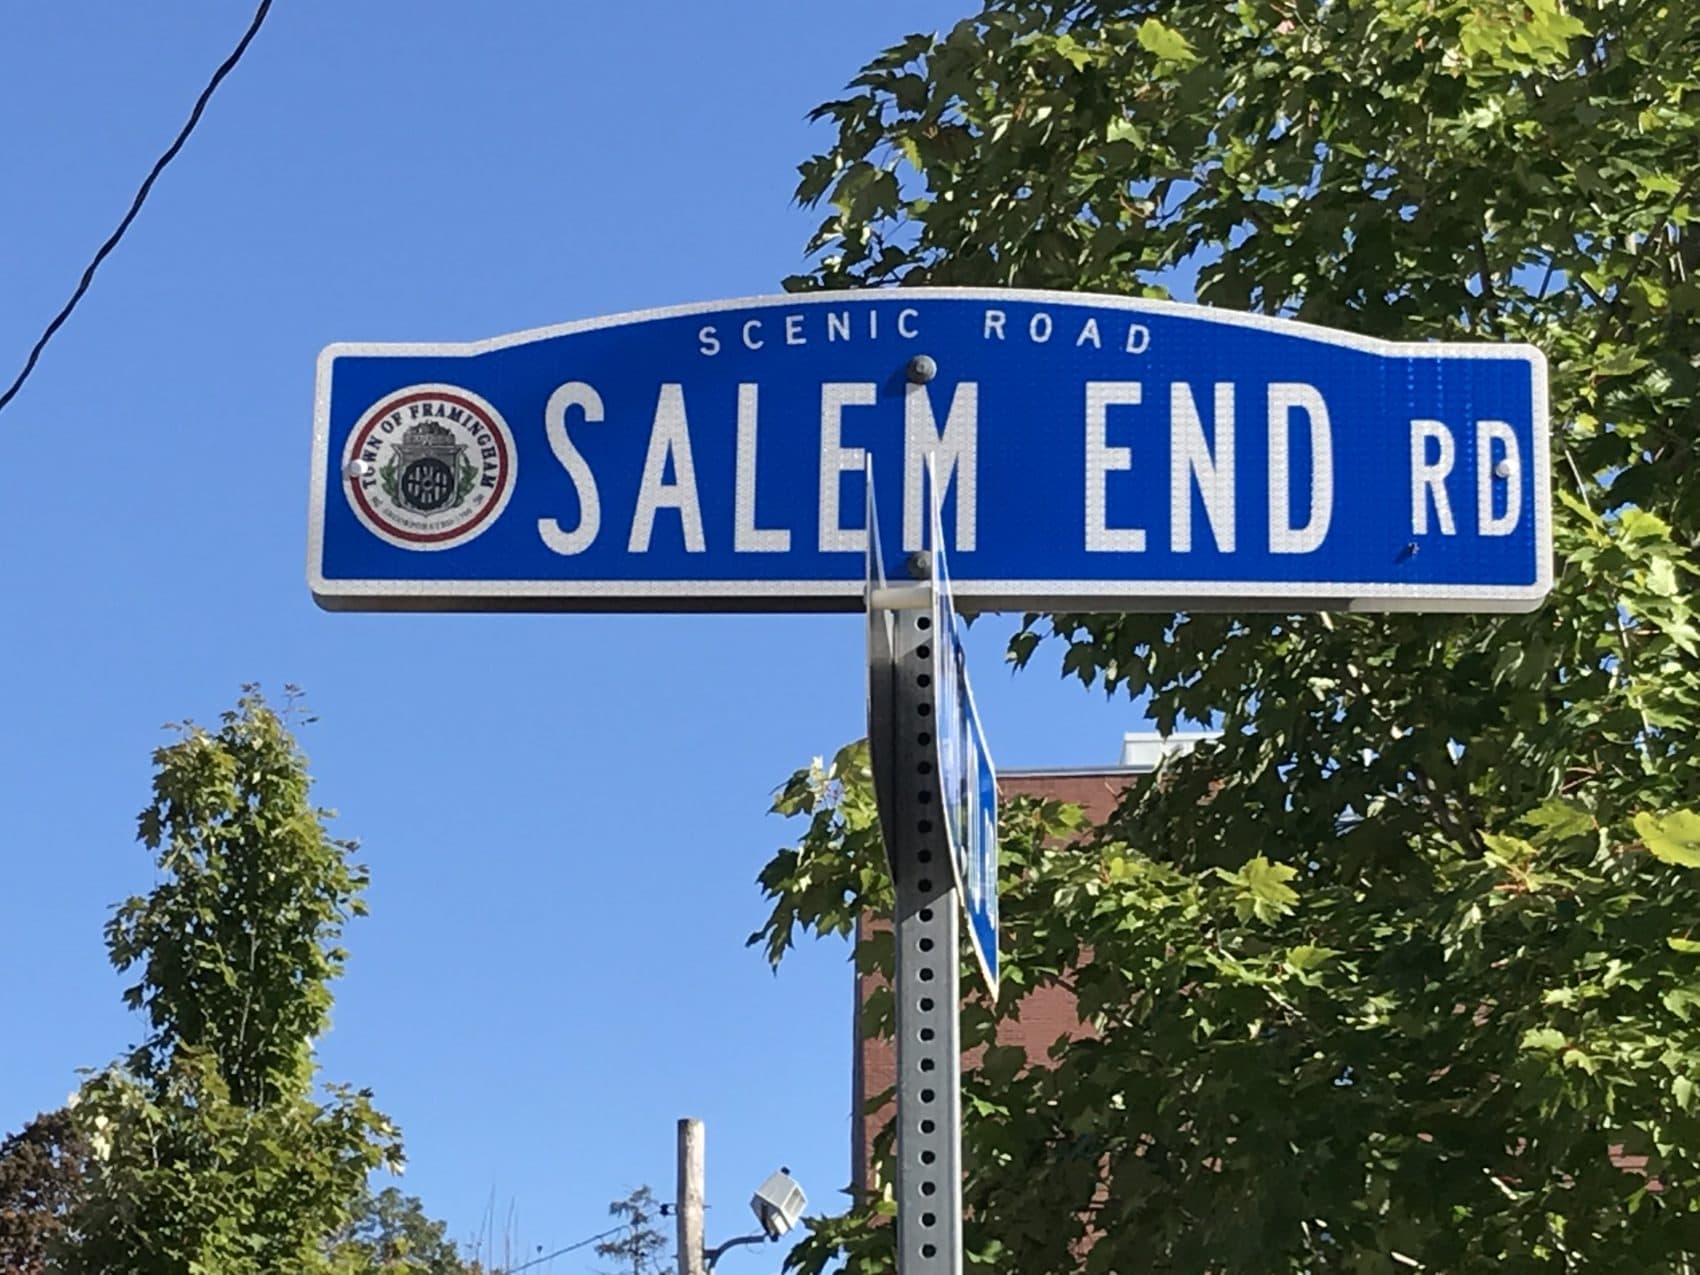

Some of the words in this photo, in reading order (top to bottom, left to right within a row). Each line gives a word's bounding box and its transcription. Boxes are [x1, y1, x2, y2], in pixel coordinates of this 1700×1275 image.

[698, 308, 920, 357] SCENIC
[983, 309, 1152, 355] ROAD
[362, 436, 383, 489] TOWN
[381, 412, 402, 433] OF
[410, 403, 498, 489] FRAMINGHAM
[537, 380, 979, 556] SALEM
[1084, 381, 1334, 555] END
[1409, 419, 1523, 537] RD
